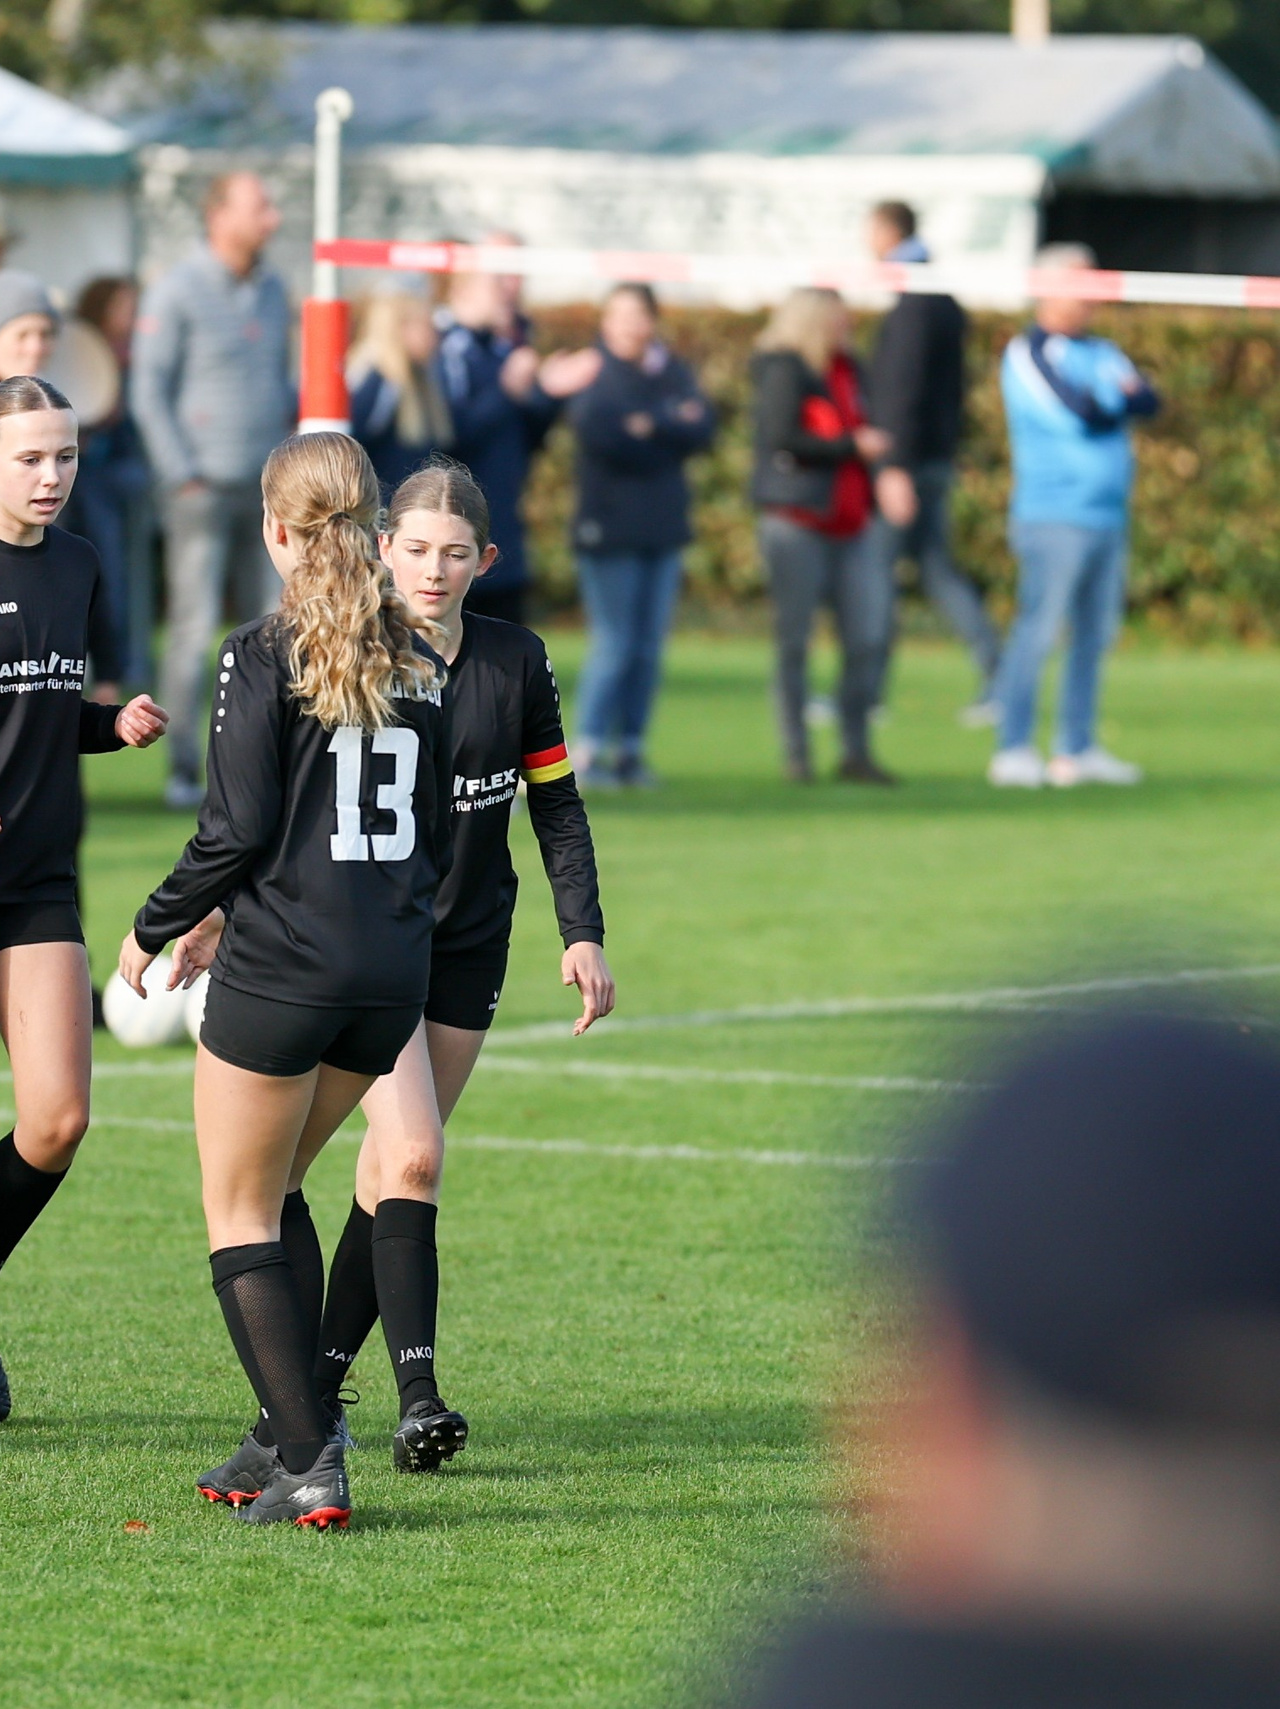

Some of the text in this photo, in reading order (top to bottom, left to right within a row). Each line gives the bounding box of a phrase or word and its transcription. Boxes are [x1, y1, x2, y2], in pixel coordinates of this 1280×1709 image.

[47, 678, 62, 690] für
[326, 726, 420, 862] 13
[466, 768, 517, 796] FLEX
[455, 800, 472, 812] für
[473, 787, 515, 810] Hydraulik
[400, 1346, 433, 1364] JAKO
